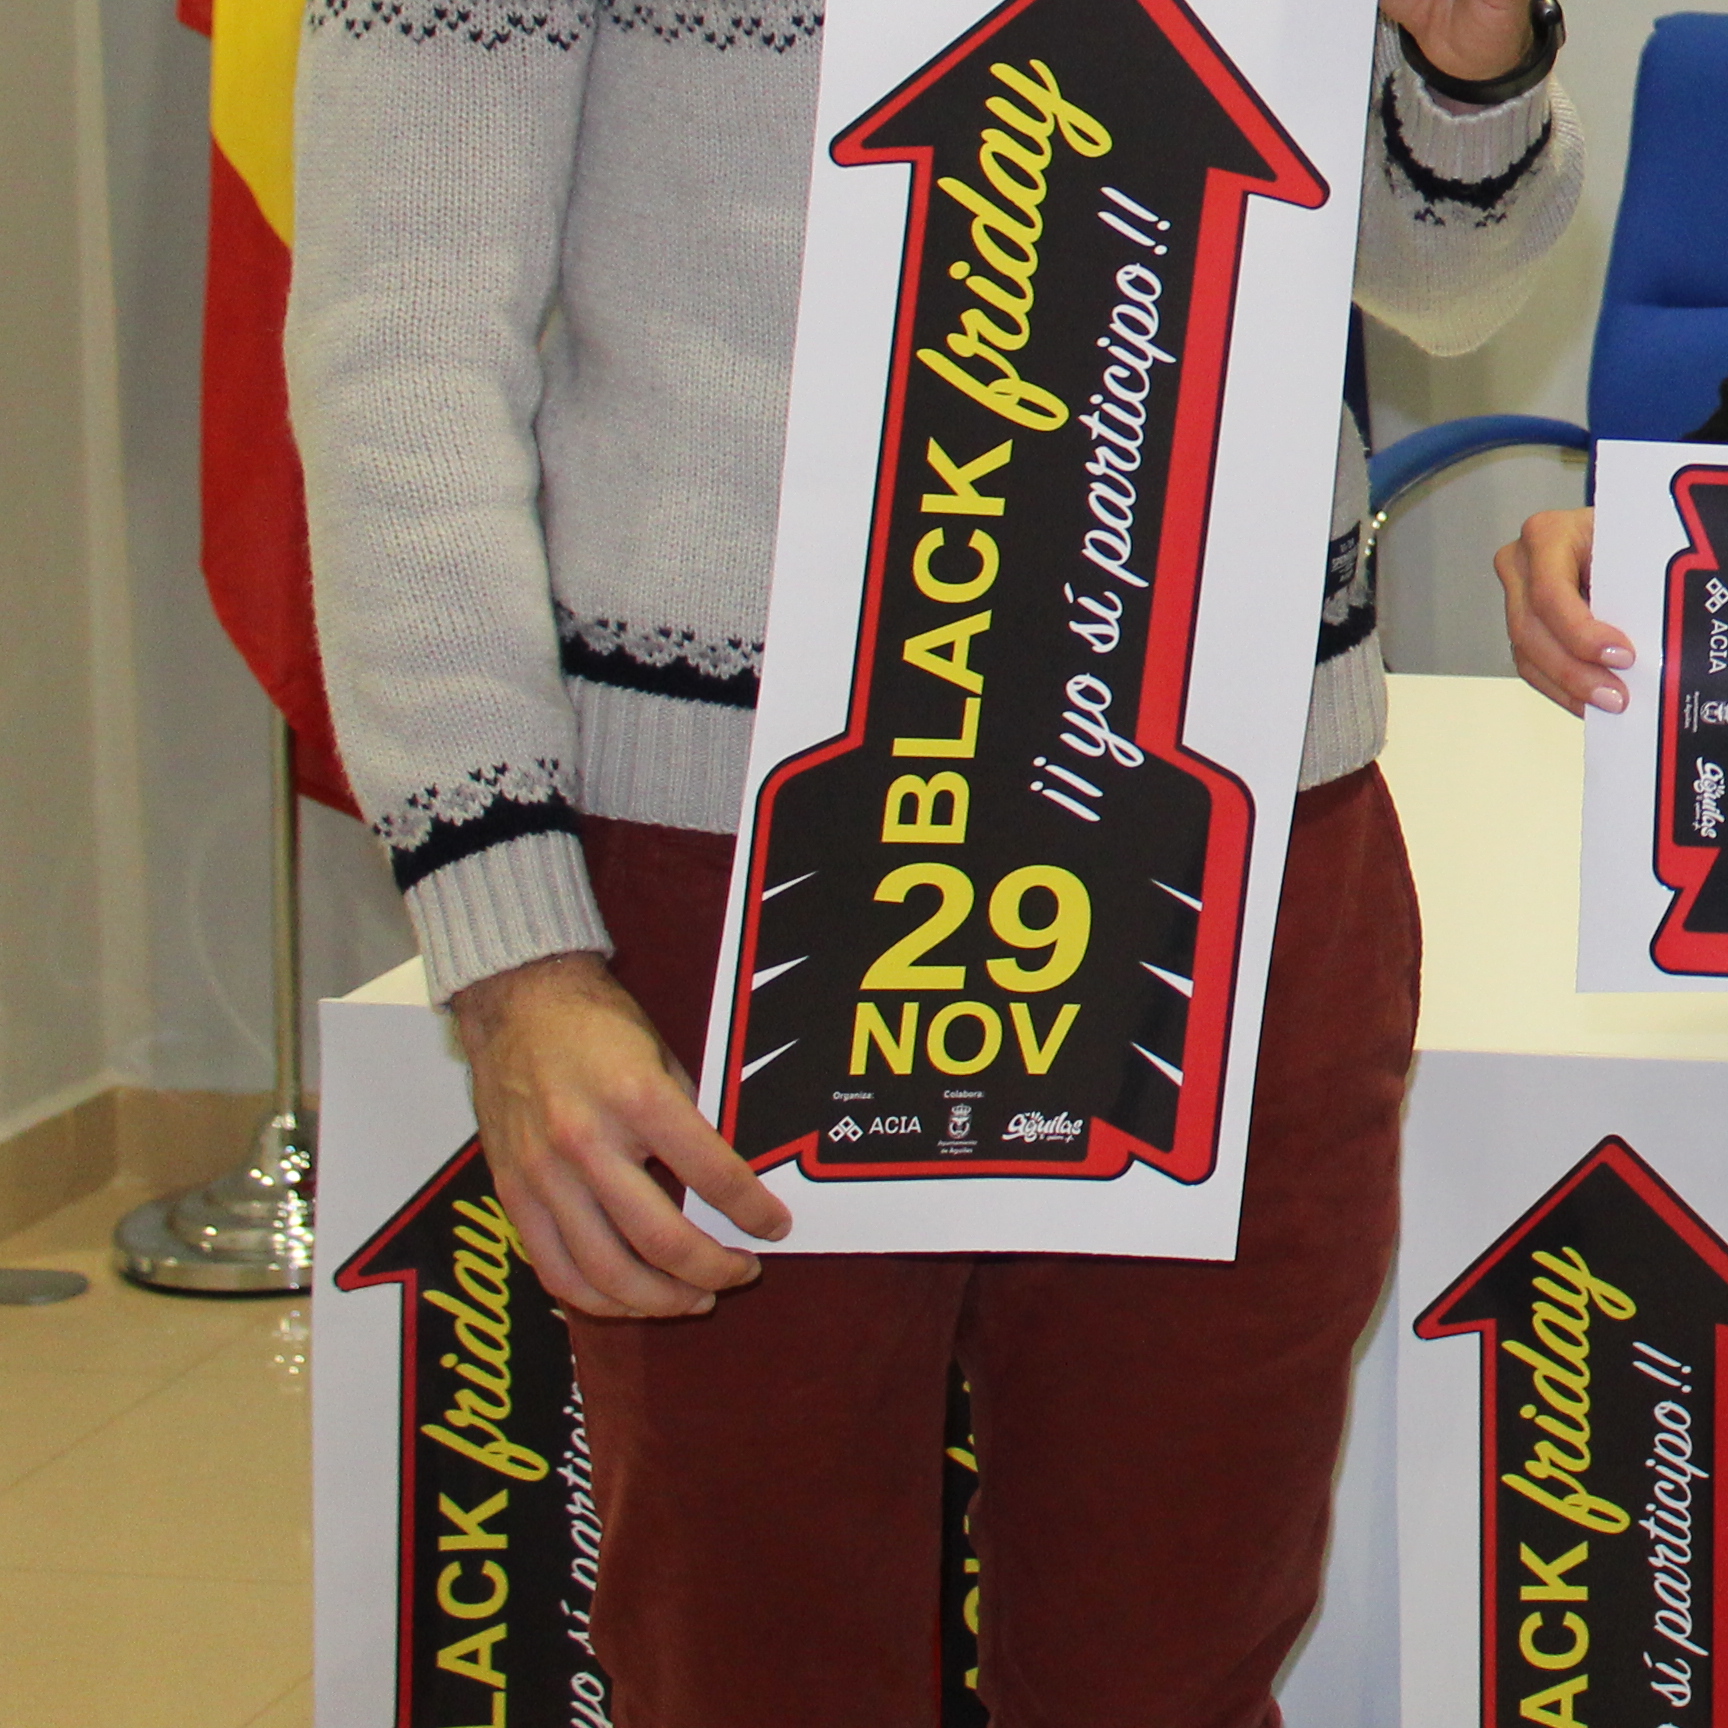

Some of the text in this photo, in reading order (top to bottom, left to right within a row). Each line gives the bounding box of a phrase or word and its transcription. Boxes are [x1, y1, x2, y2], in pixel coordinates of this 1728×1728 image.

[882, 58, 1112, 844] BLACK friday
[1063, 582, 1123, 654] sí
[859, 862, 1092, 993] 29
[849, 1000, 1083, 1076] NOV
[868, 1115, 922, 1135] ACIA
[1502, 1246, 1637, 1534] friday
